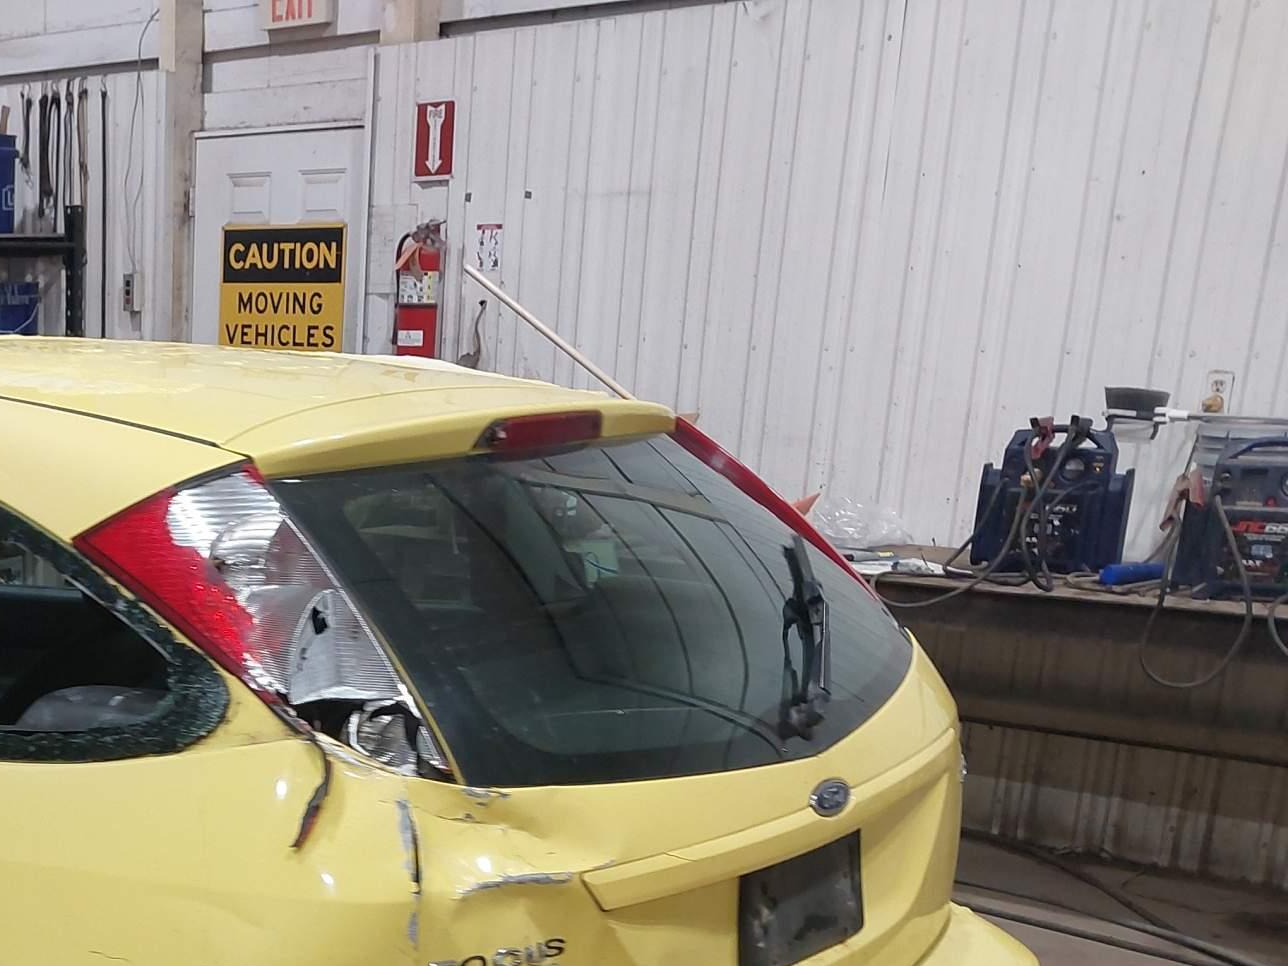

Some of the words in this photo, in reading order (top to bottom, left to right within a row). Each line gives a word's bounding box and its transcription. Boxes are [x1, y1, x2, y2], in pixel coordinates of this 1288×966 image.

[229, 241, 337, 270] CAUTION
[238, 291, 323, 315] MOVING
[225, 323, 335, 348] VEHICLES
